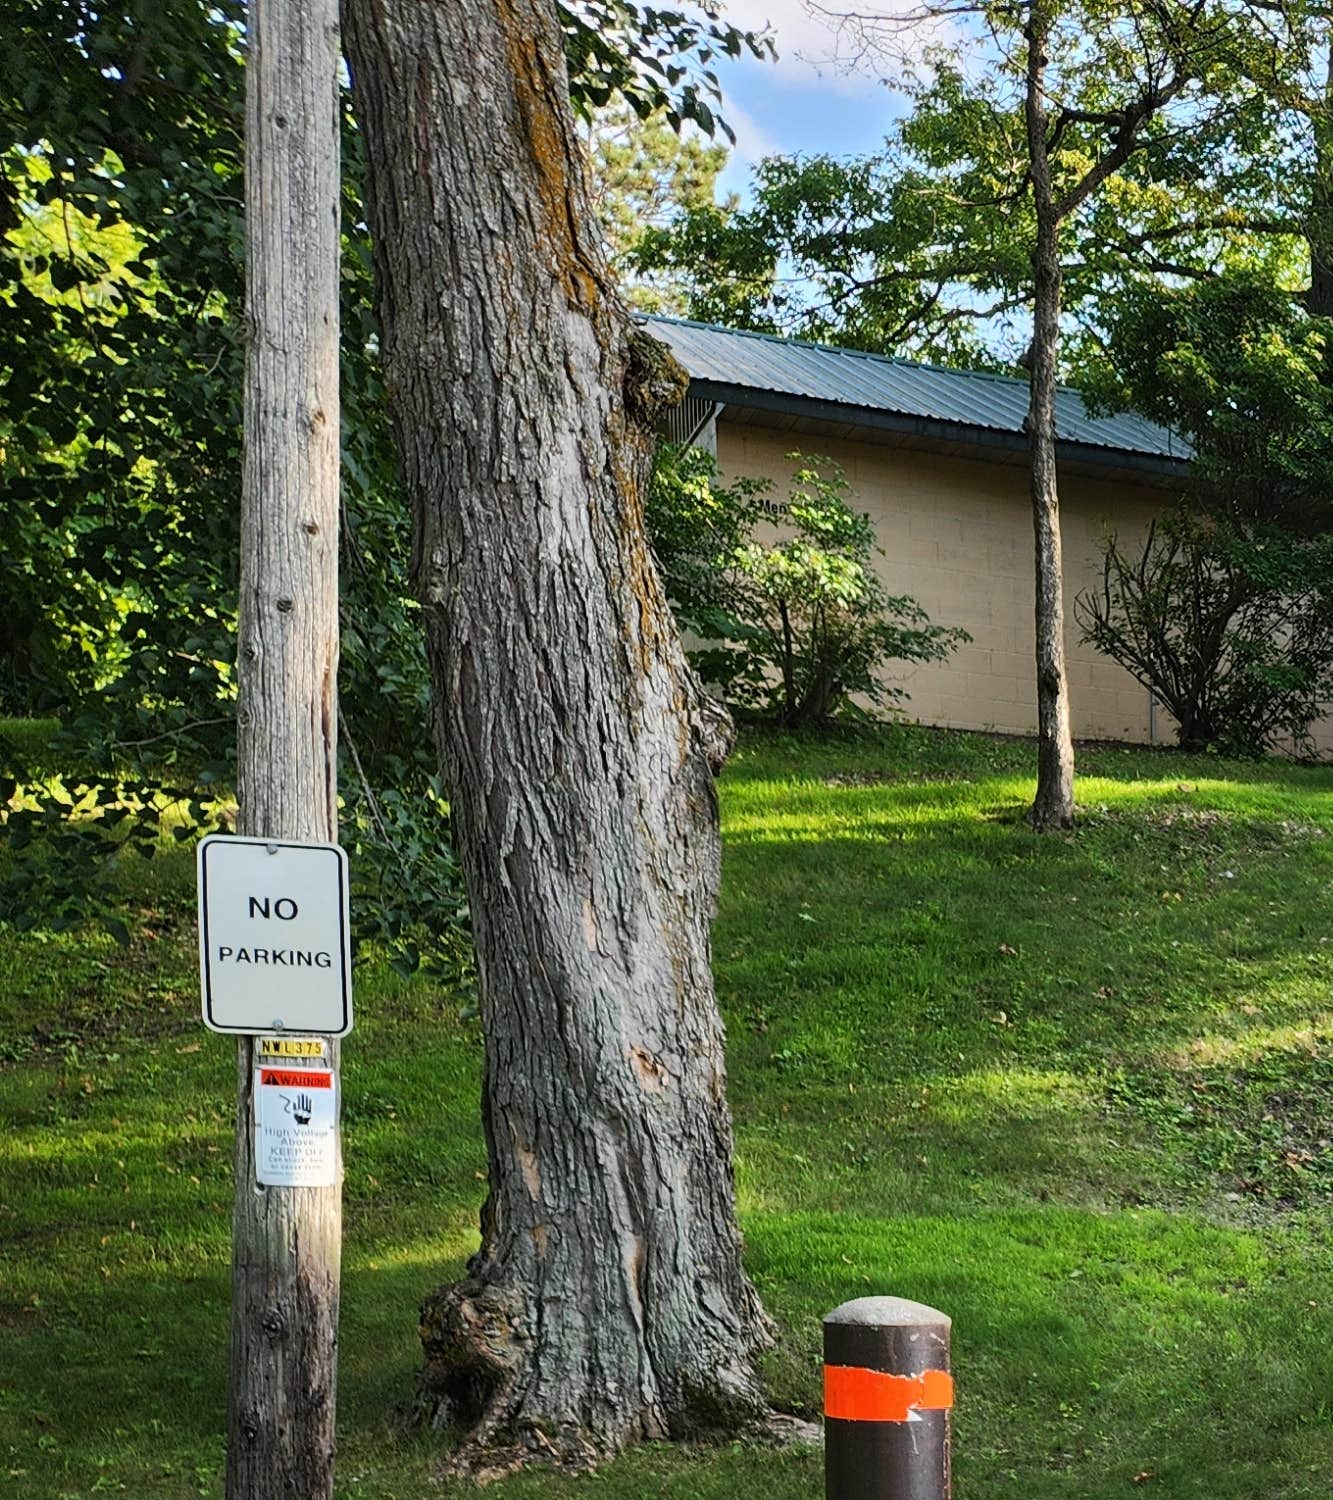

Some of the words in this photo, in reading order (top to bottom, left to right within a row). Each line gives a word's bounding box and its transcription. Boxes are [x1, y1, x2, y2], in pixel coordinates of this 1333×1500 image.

[248, 896, 299, 921] NO
[218, 946, 333, 969] PARKING
[296, 1041, 322, 1055] 375
[280, 1074, 330, 1088] WARNING
[265, 1127, 290, 1138] High
[280, 1137, 314, 1146] Above
